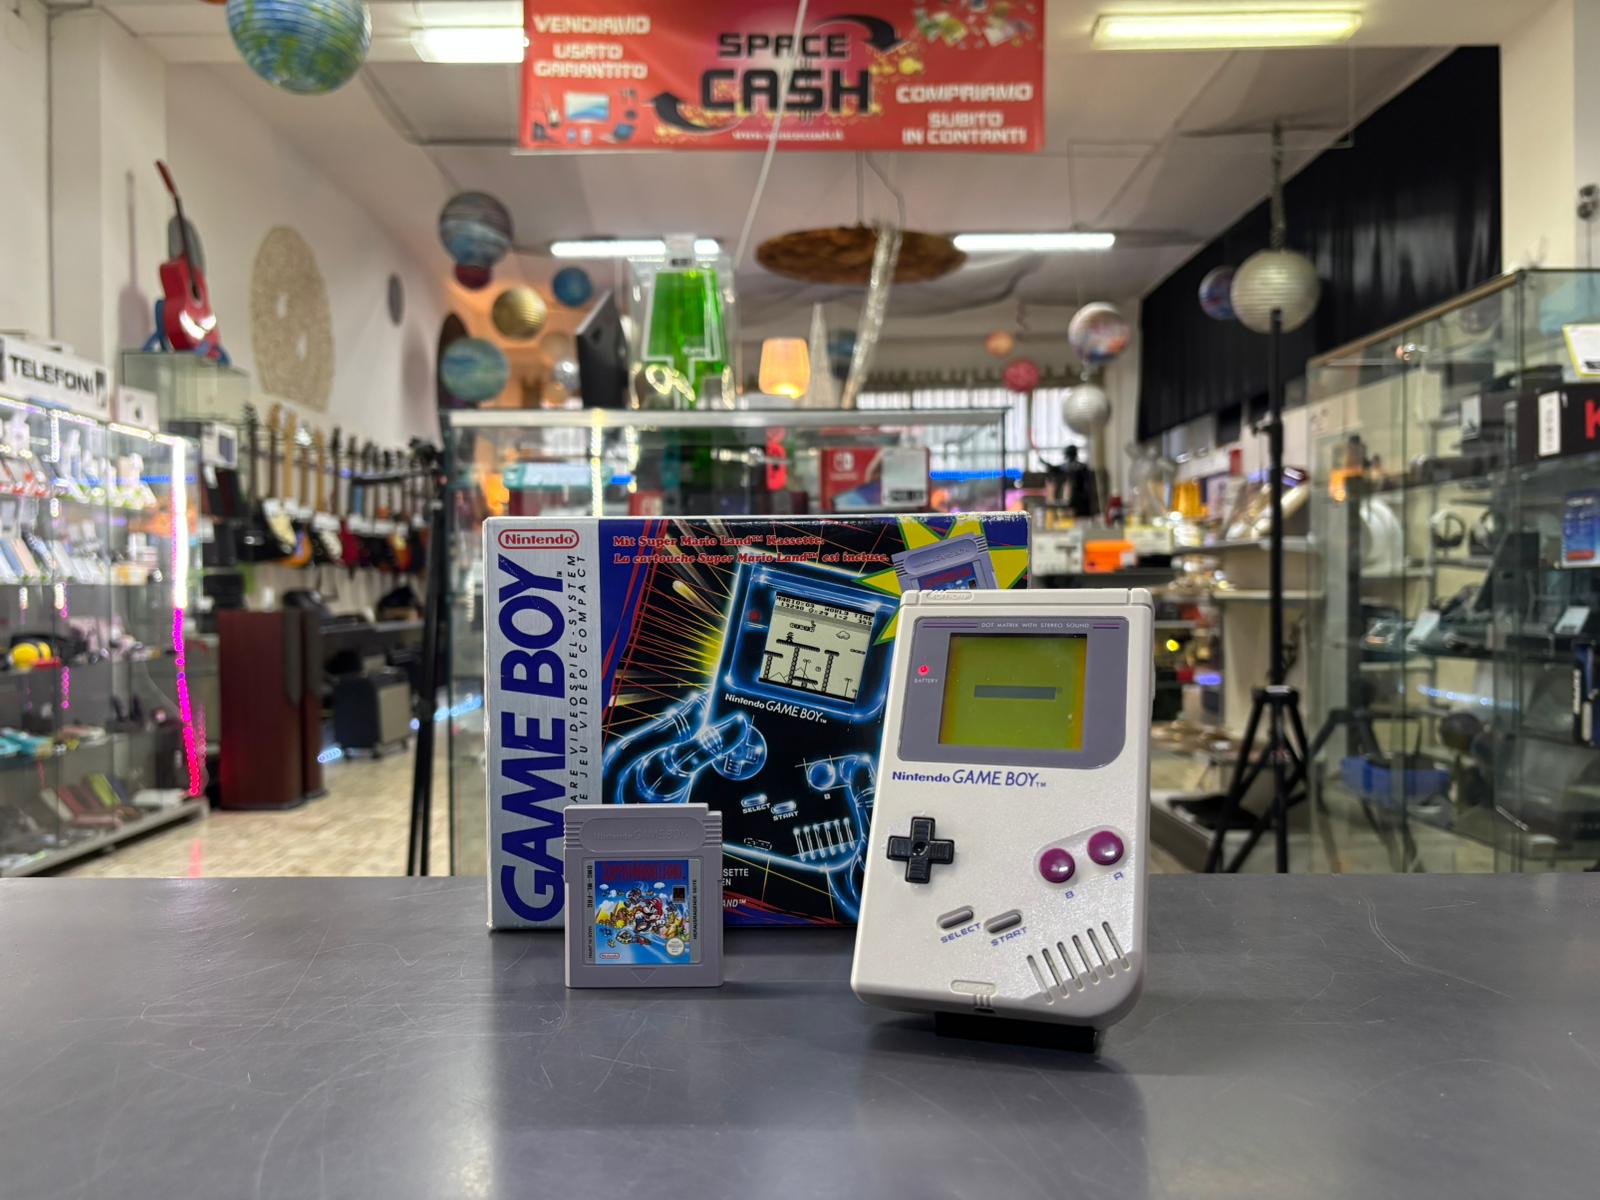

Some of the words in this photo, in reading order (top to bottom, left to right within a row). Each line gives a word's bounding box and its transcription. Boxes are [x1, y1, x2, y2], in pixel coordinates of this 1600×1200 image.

[532, 15, 651, 35] VENDIAMO
[553, 43, 624, 60] USATO
[718, 33, 847, 58] SPACE
[533, 61, 648, 79] GARANTITO
[702, 69, 870, 113] CASH
[896, 83, 1034, 103] COMPRIAMO
[927, 111, 1004, 128] SUBITO
[902, 128, 924, 145] IN
[927, 127, 1027, 145] CONTANTI
[8, 354, 94, 396] TELEFONI
[613, 535, 636, 547] Mit
[638, 536, 677, 548] Super
[680, 536, 718, 547] Mario
[766, 535, 825, 546] Kassette.
[613, 553, 631, 564] La
[633, 554, 696, 564] cartouche
[697, 554, 734, 565] Super
[737, 553, 773, 564] Mario
[822, 552, 841, 563] est
[576, 556, 588, 654] COMPACT
[567, 554, 579, 755] VIDEOSPIEL-SYSTEM
[725, 693, 765, 709] Nintendo
[765, 700, 798, 717] GAME
[578, 746, 589, 779] JEU
[892, 771, 950, 783] Nintendo
[952, 769, 1001, 786] GAME
[500, 710, 566, 922] GAME
[742, 802, 771, 814] SELECT
[773, 810, 799, 821] START
[722, 868, 749, 877] SETTE
[1113, 871, 1123, 880] A
[1065, 891, 1074, 899] B
[940, 922, 982, 944] SELECT
[990, 926, 1028, 947] START
